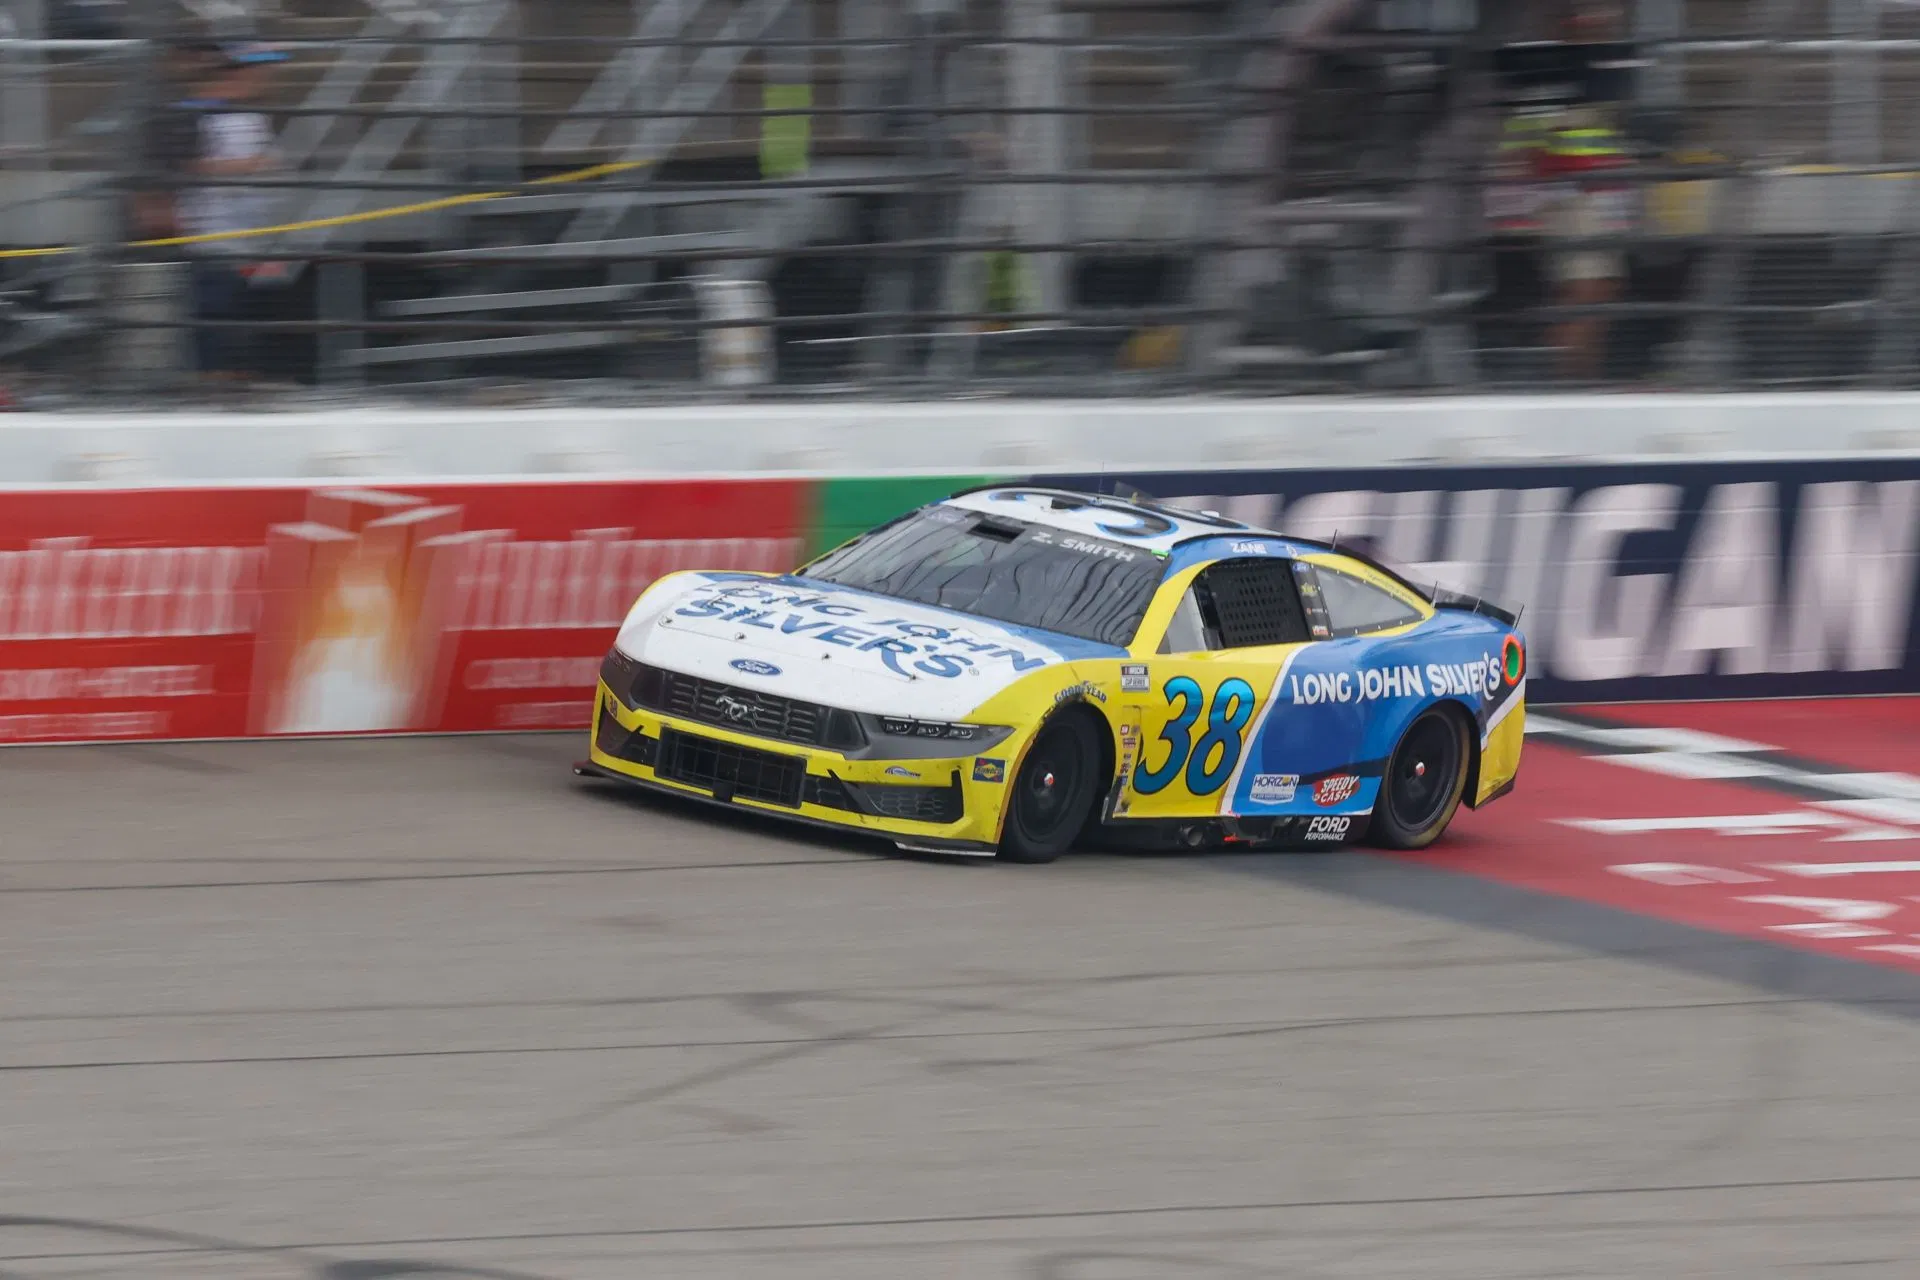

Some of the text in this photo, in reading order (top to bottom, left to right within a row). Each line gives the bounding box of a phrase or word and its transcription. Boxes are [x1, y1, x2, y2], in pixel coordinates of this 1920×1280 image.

[1031, 531, 1136, 562] Z. SMITH
[1230, 543, 1267, 554] ZANE
[863, 618, 1047, 672] JOHN
[734, 659, 776, 675] Ford
[1290, 651, 1500, 704] LONG JOHN SILVER'S
[1132, 675, 1256, 797] 38
[1253, 776, 1298, 787] HORIZON
[1320, 775, 1360, 794] SPEEDY
[1320, 789, 1352, 804] CASH
[1308, 816, 1351, 833] FORD
[1304, 832, 1346, 841] PERFORMANCE
